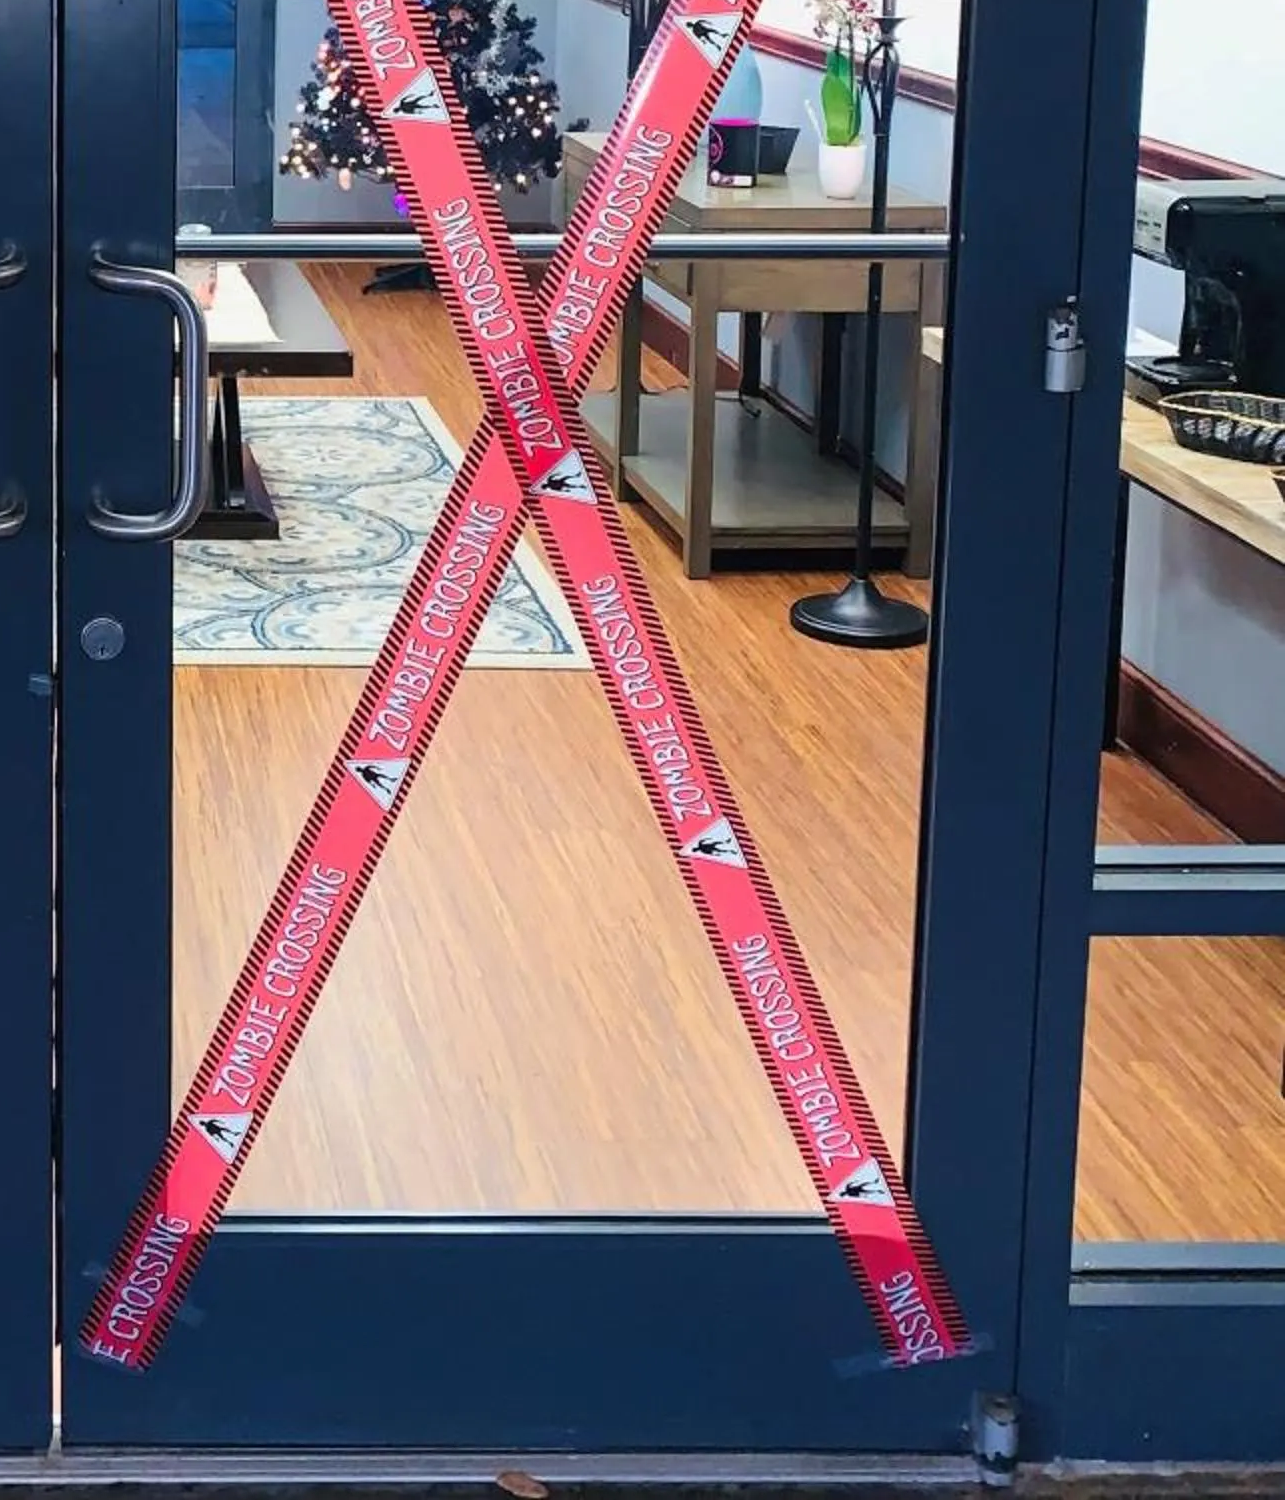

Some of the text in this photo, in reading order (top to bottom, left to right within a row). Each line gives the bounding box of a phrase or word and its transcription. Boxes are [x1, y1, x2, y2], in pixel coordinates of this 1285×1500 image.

[433, 197, 564, 458] ZOMBIE CROSSING
[546, 124, 674, 377] OMBIE CROSSING
[368, 499, 507, 752] ZOMBIE CROSSING
[581, 574, 712, 823] ZOMBIE CROSSING
[212, 861, 347, 1109] ZOMBIE CROSSING
[733, 932, 861, 1169] ZOMBIE CROSSING
[107, 1211, 192, 1343] CROSSING
